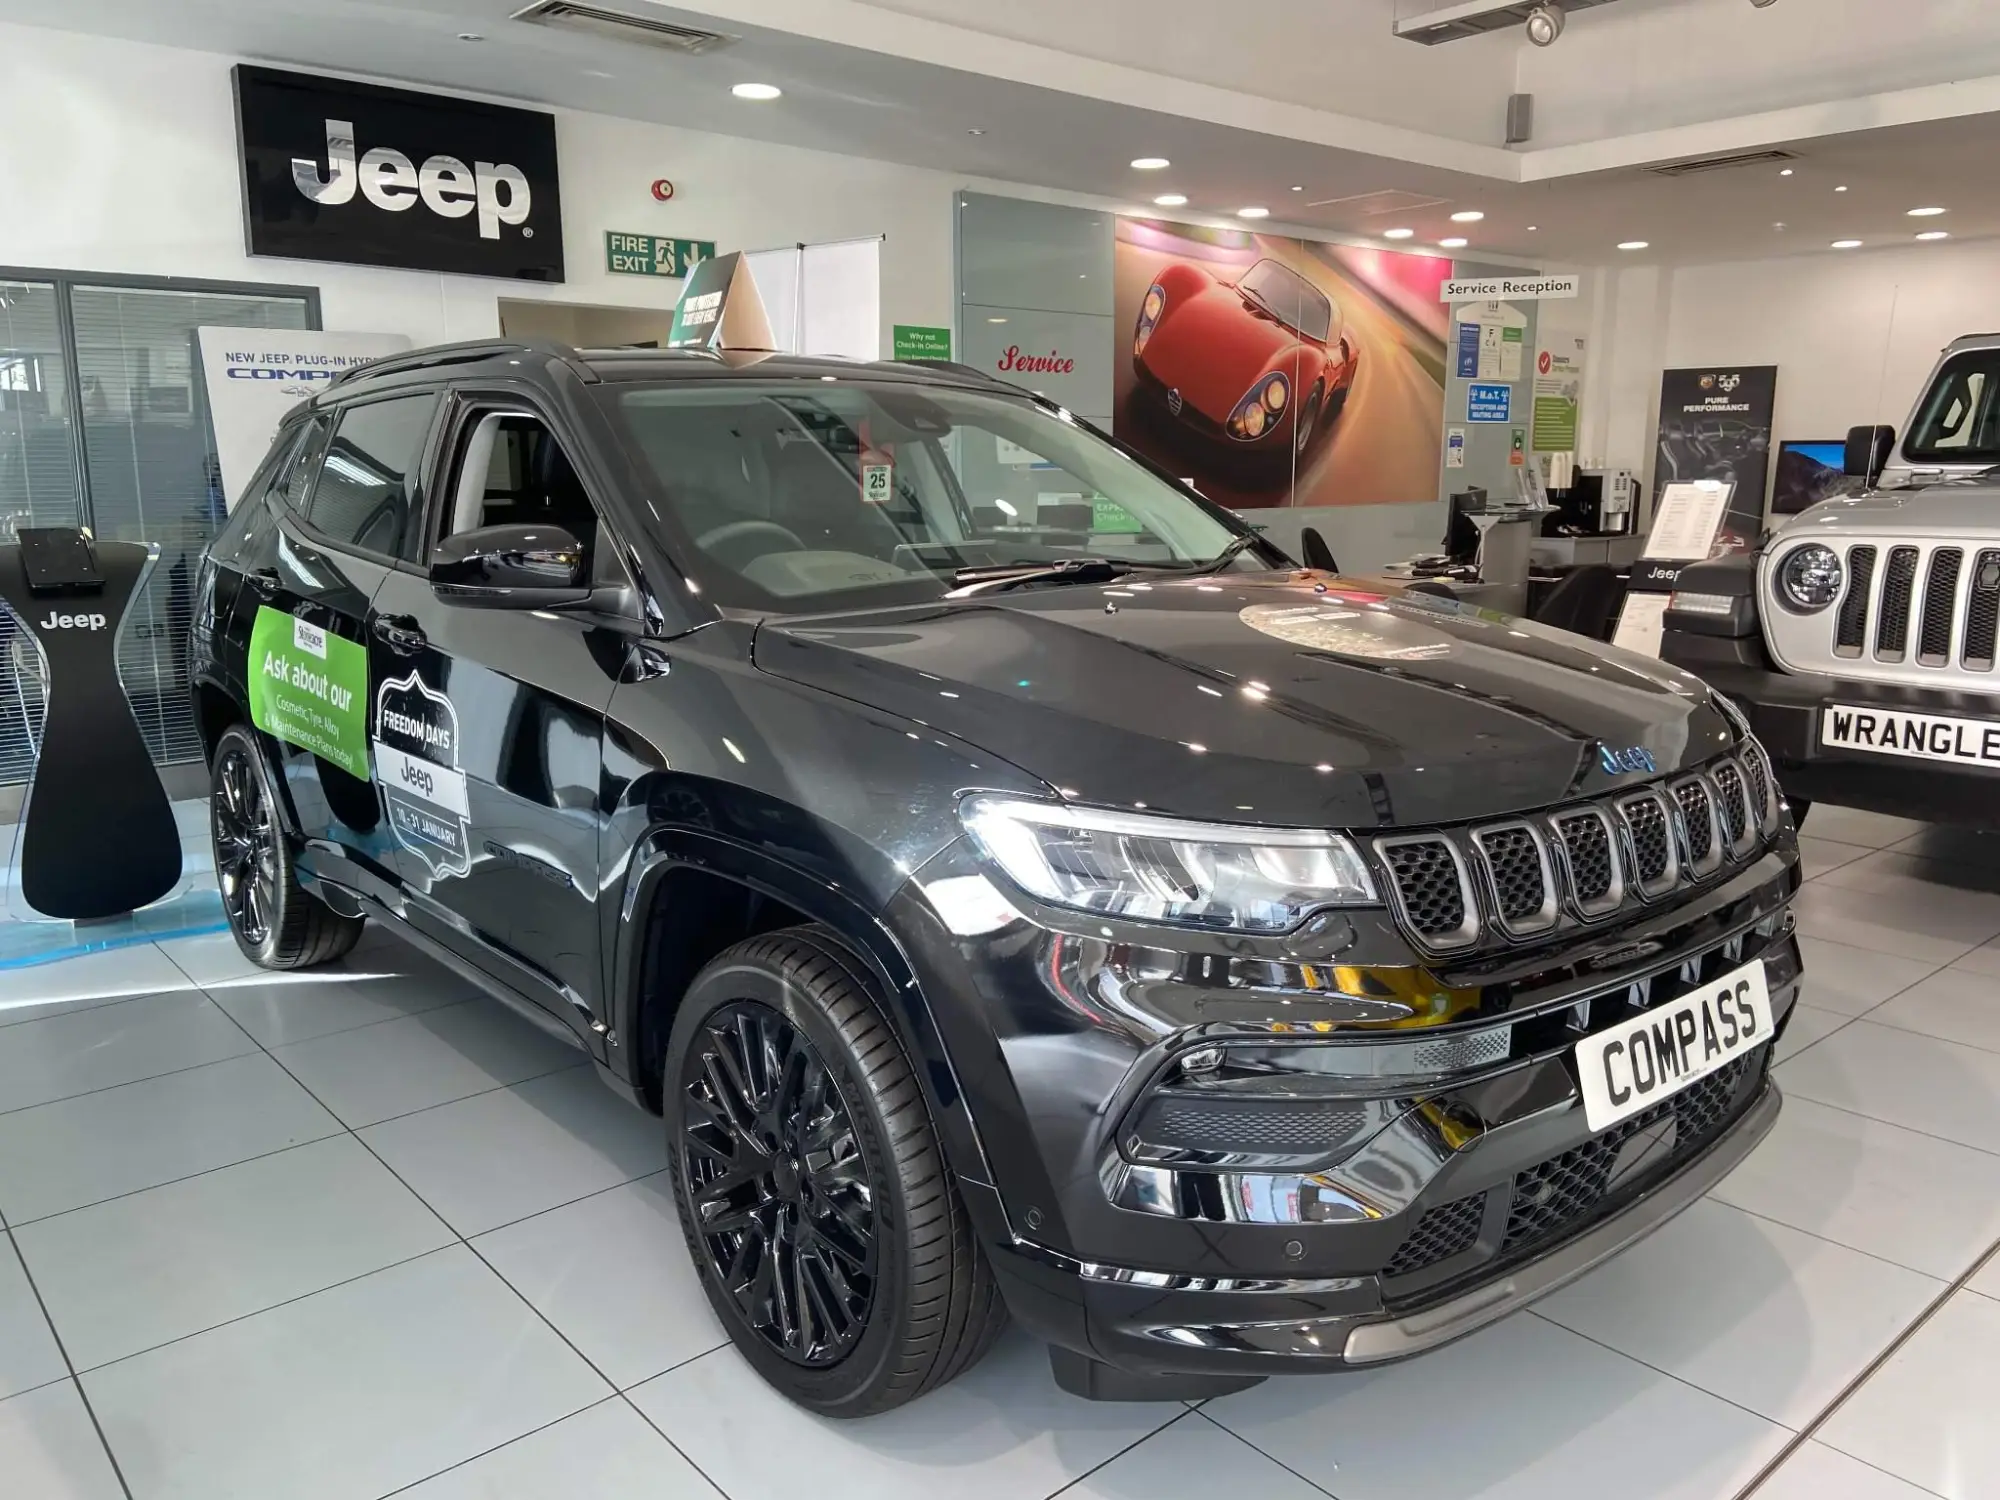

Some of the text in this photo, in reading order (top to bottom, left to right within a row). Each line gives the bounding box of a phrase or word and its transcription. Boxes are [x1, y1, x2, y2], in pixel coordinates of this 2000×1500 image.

[611, 235, 649, 253] FIRE
[612, 255, 649, 272] EXIT
[1447, 280, 1572, 295] Service Reception
[909, 333, 924, 341] Why
[225, 352, 255, 363] NEW
[295, 355, 346, 366] PLUG-IN
[998, 345, 1074, 374] Service
[1683, 404, 1750, 412] PERFORMANCE
[870, 473, 886, 489] 25
[40, 611, 107, 631] Jeep
[262, 650, 352, 713] Ask about our
[271, 713, 316, 747] Maintenance
[316, 734, 334, 757] Plans
[383, 709, 450, 750] FREEDOM DAYS
[401, 756, 434, 797] Jeep
[421, 818, 456, 847] JANUARY
[1602, 979, 1756, 1107] COMPASS
